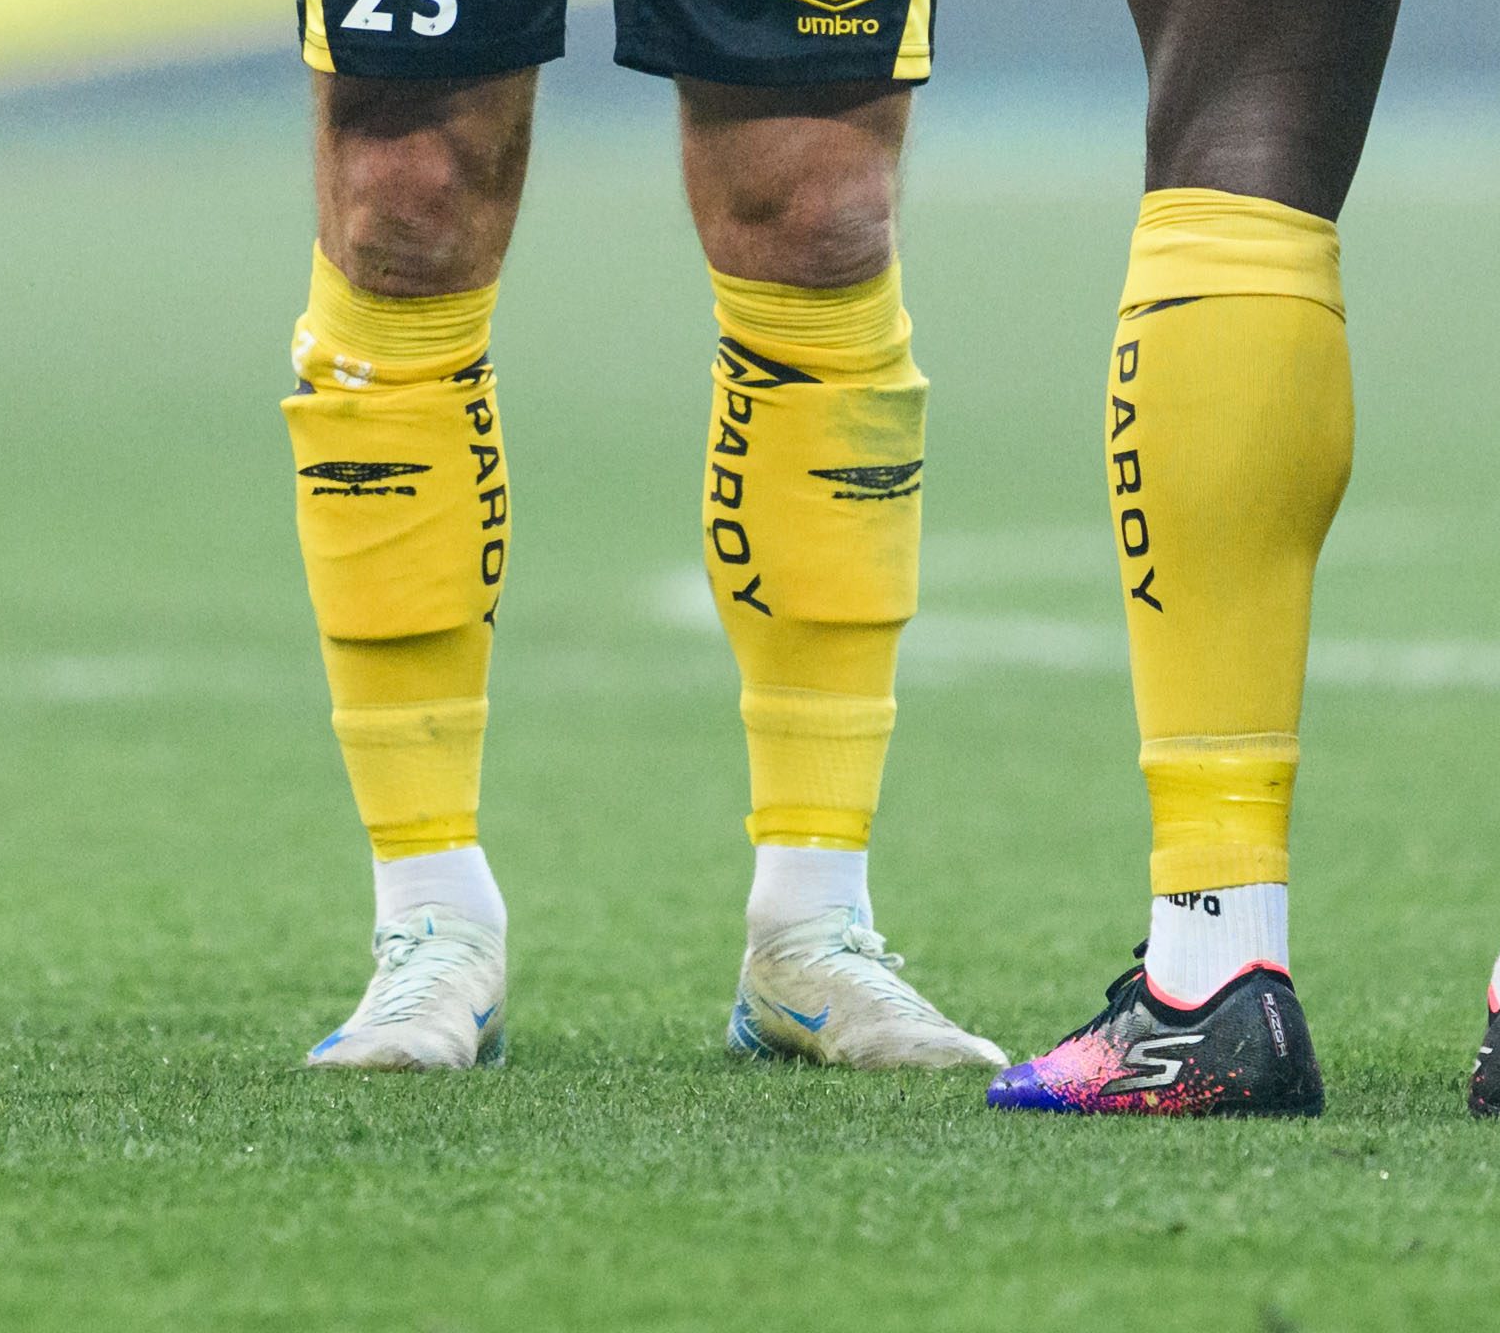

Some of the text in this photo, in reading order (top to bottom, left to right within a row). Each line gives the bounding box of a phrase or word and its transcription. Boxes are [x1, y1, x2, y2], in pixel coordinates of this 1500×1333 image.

[797, 15, 880, 37] umbro
[709, 386, 773, 618] PAROY
[1111, 339, 1165, 614] PAROY
